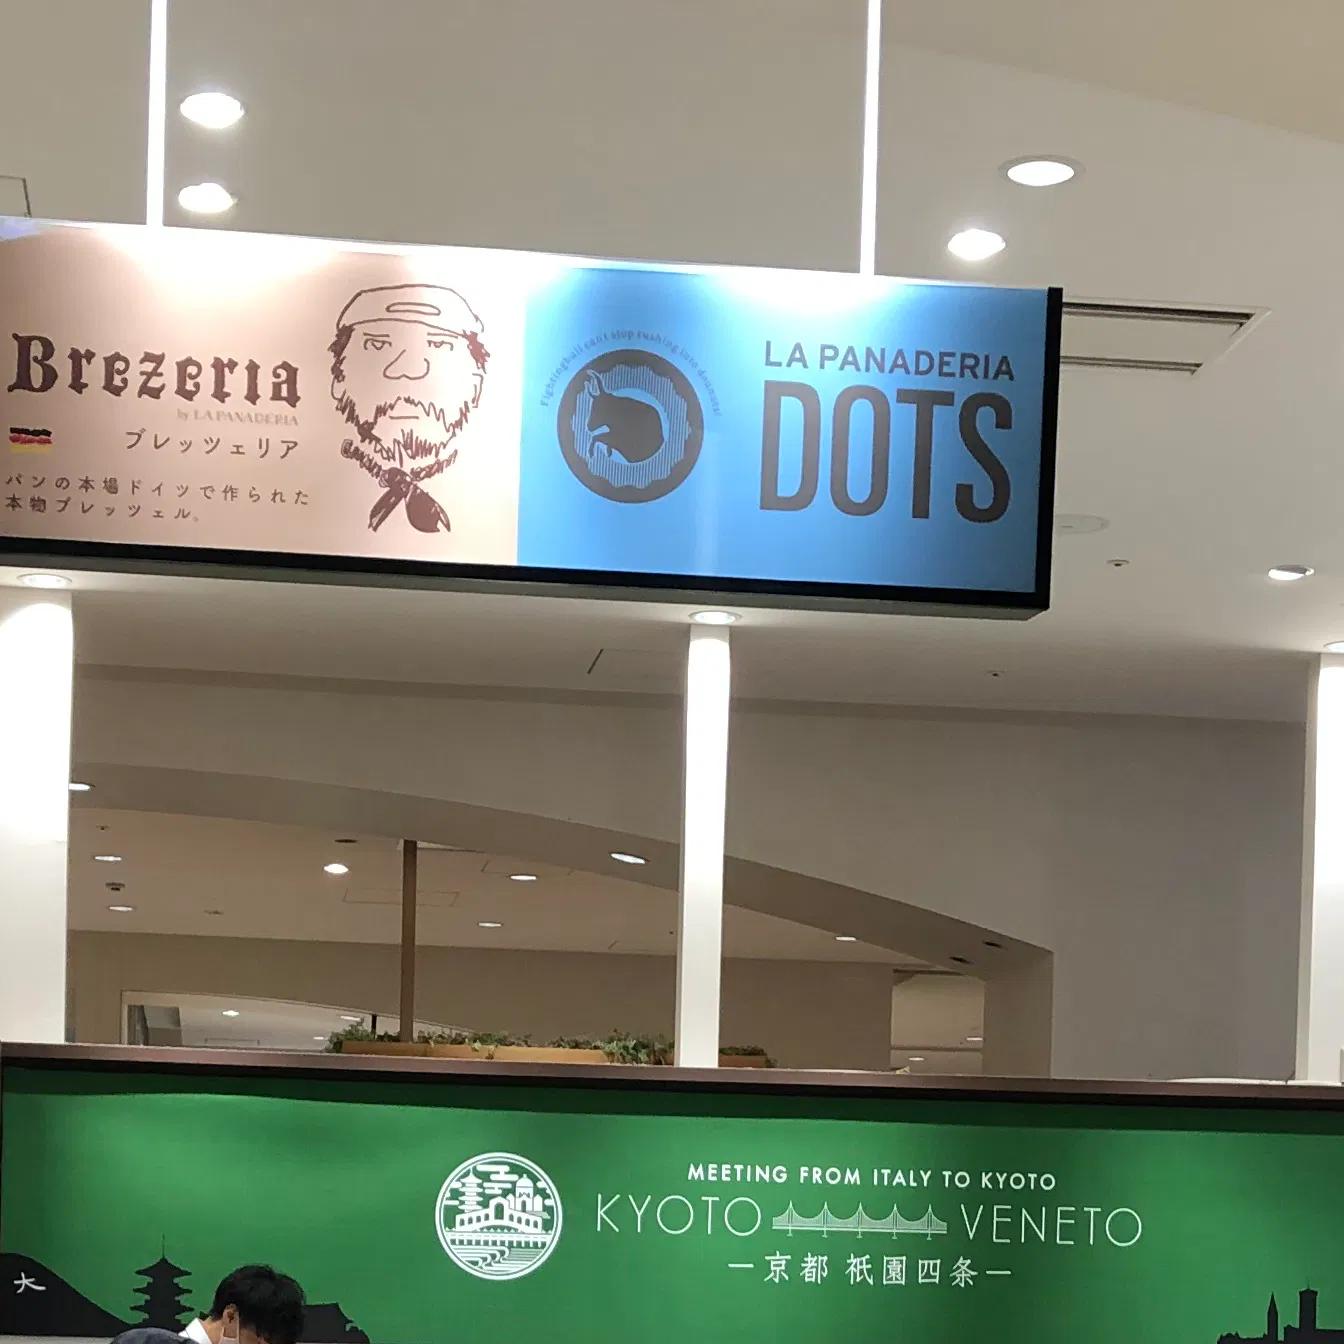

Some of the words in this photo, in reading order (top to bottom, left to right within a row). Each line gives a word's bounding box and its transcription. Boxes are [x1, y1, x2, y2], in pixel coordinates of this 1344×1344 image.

[6, 332, 301, 408] Brezeria
[764, 340, 809, 369] LA
[818, 343, 1016, 382] PANADERIA
[125, 428, 299, 460] ブレッツェリア
[759, 379, 1014, 525] DOTS
[5, 474, 309, 505] パンの本場ドイツで作られた
[687, 1163, 788, 1185] MEETING
[799, 1166, 862, 1187] FROM
[872, 1168, 932, 1189] ITALY
[941, 1170, 971, 1189] TO
[980, 1171, 1057, 1191] KYOTO
[596, 1192, 763, 1238] KYOTO
[959, 1202, 1144, 1249] VENETO
[762, 1250, 829, 1286] 京都
[843, 1252, 979, 1288] 祇園四条
